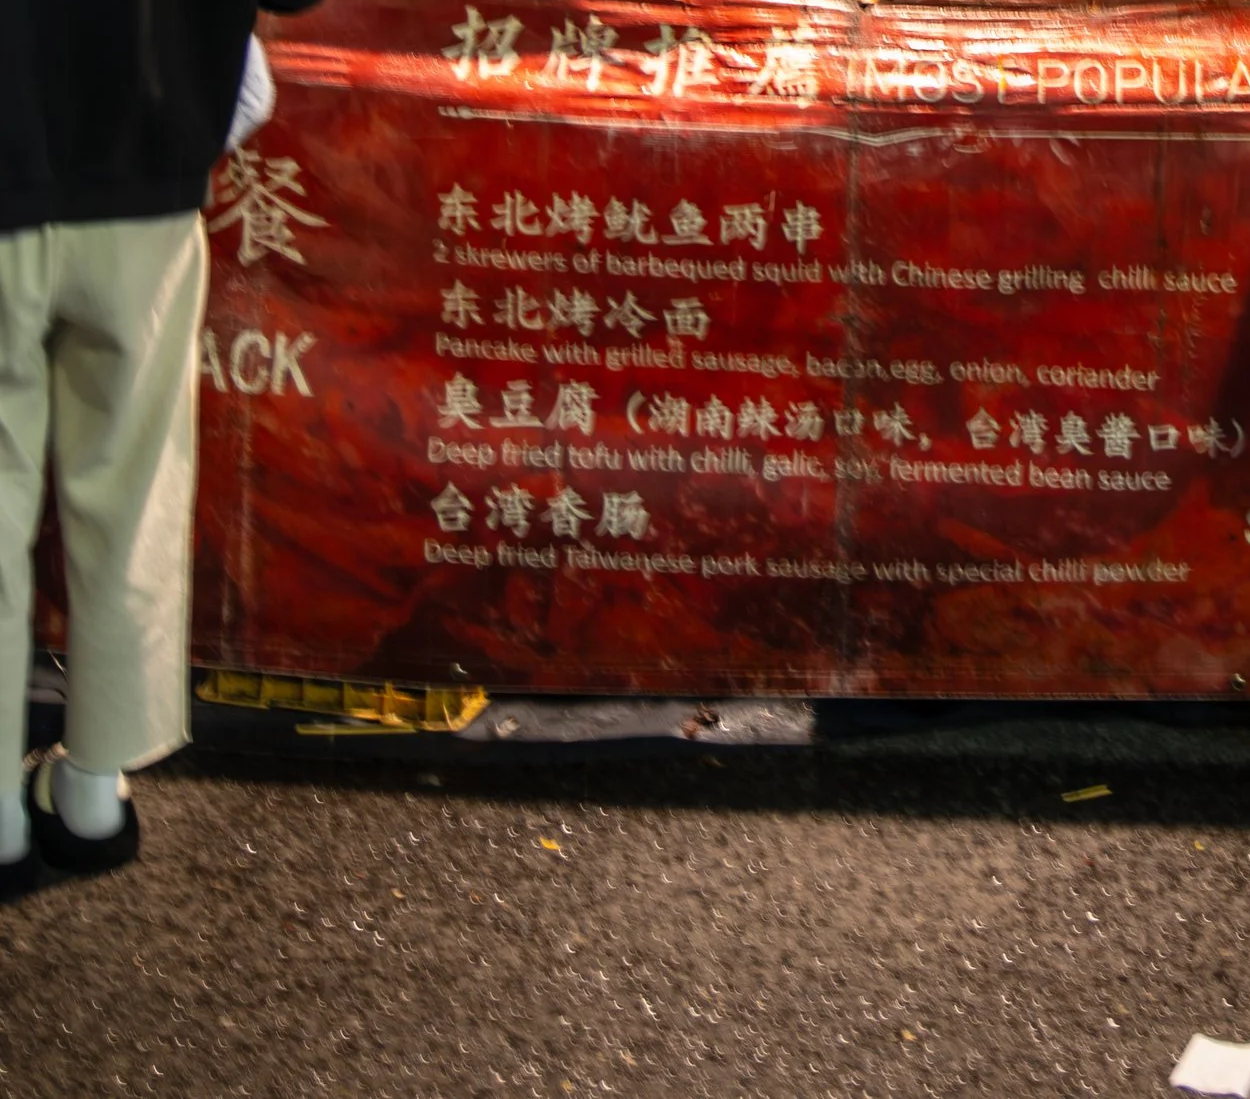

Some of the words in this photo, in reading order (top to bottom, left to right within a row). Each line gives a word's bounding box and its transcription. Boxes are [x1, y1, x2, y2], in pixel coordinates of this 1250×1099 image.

[432, 240, 450, 264] 2
[455, 245, 568, 275] skrewers
[573, 250, 602, 275] of
[606, 252, 747, 285] barbequed
[752, 256, 823, 286] squid
[828, 258, 885, 286] with
[891, 259, 993, 290] Chinese
[998, 263, 1086, 297] grilling
[1098, 261, 1157, 292] chilli
[1163, 267, 1238, 294] sauce
[441, 279, 711, 342] 东北烤冷面
[435, 331, 537, 364] Pancake
[542, 338, 599, 367] with
[605, 341, 686, 373] grilled
[691, 346, 801, 378] sausage,
[950, 357, 1030, 388] onion,
[1036, 361, 1160, 392] coriander
[427, 435, 495, 469] Deep
[501, 436, 563, 469] fried
[568, 440, 622, 470] tofu
[628, 444, 686, 473] with
[889, 453, 1024, 487] fermented
[1029, 459, 1092, 489] bean
[1098, 467, 1172, 492] sauce
[430, 482, 650, 539] 台湾香肠
[424, 537, 492, 569] Deep
[497, 540, 556, 568] fried
[565, 546, 697, 575] Taiwanese
[701, 552, 760, 580] pork
[765, 557, 868, 584] sausage
[873, 557, 930, 583] with
[935, 559, 1024, 586] special
[1028, 557, 1087, 583] chilli
[1092, 558, 1194, 586] powder
